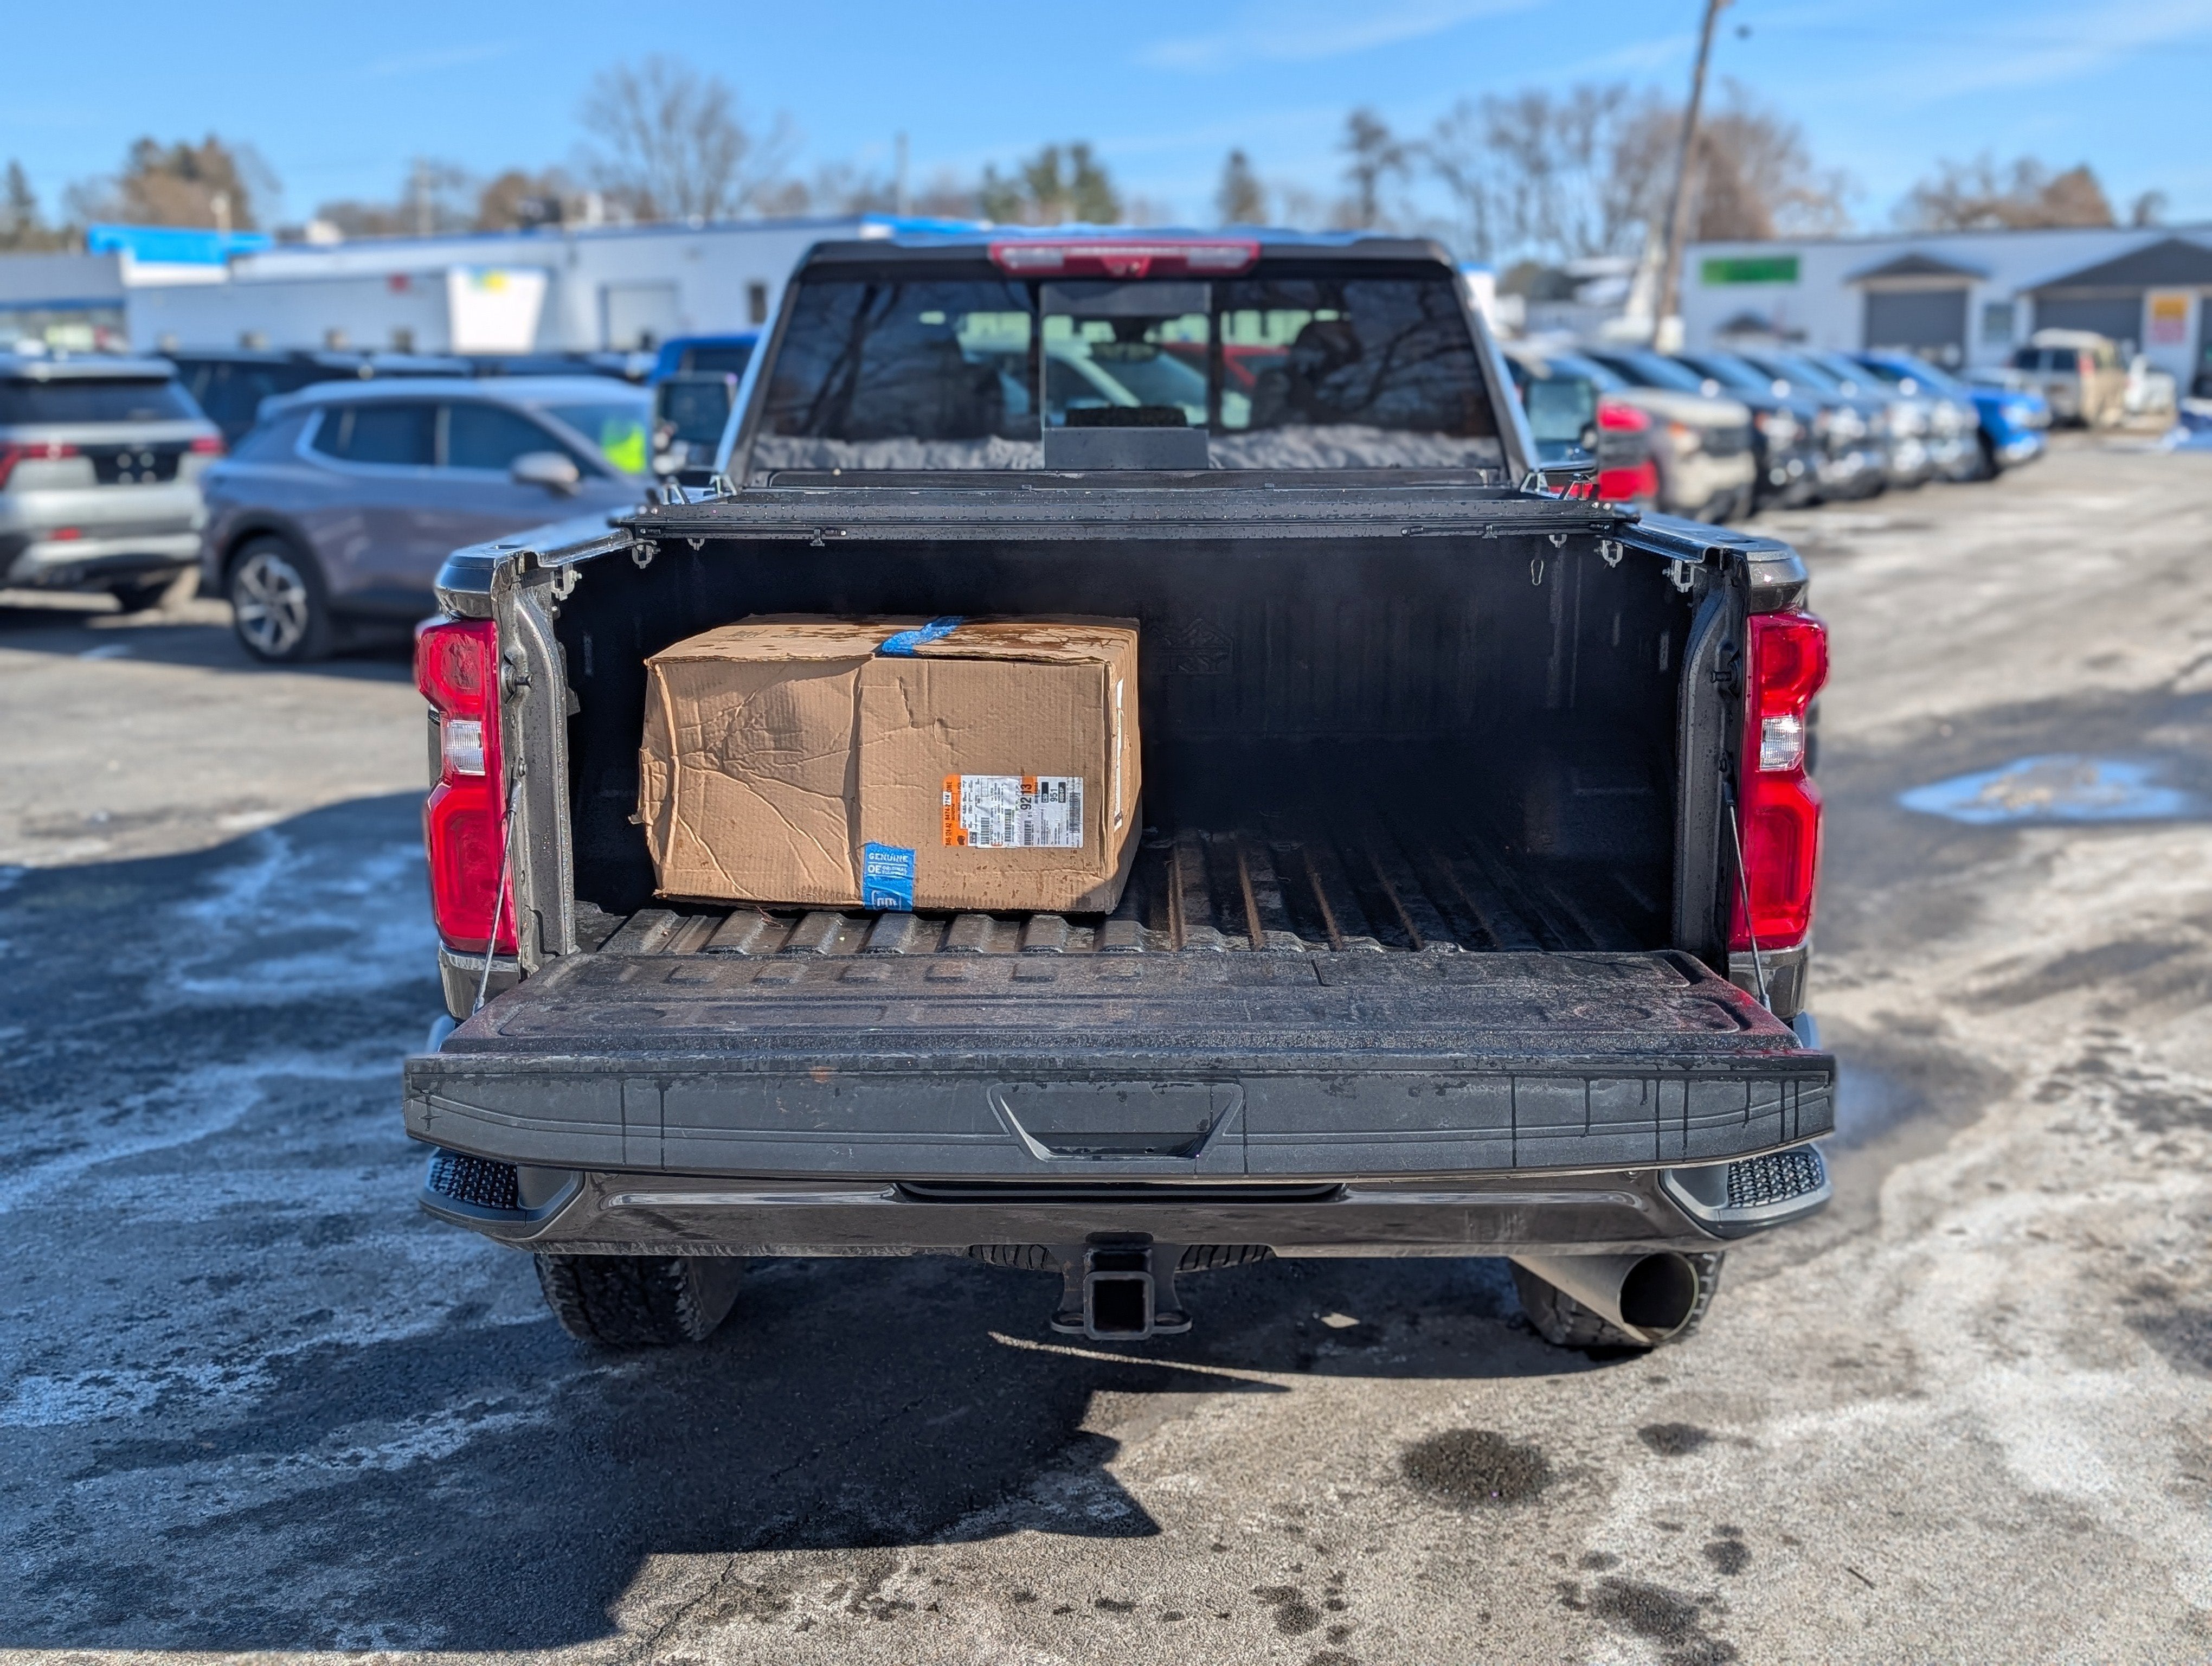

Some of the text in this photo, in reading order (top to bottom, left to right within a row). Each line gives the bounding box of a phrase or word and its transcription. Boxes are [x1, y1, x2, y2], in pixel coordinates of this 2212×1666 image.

[1020, 784, 1032, 795] 13
[1050, 789, 1058, 802] 951
[1020, 797, 1032, 810] 92
[869, 852, 909, 862] GENUINE
[867, 864, 882, 874] OE
